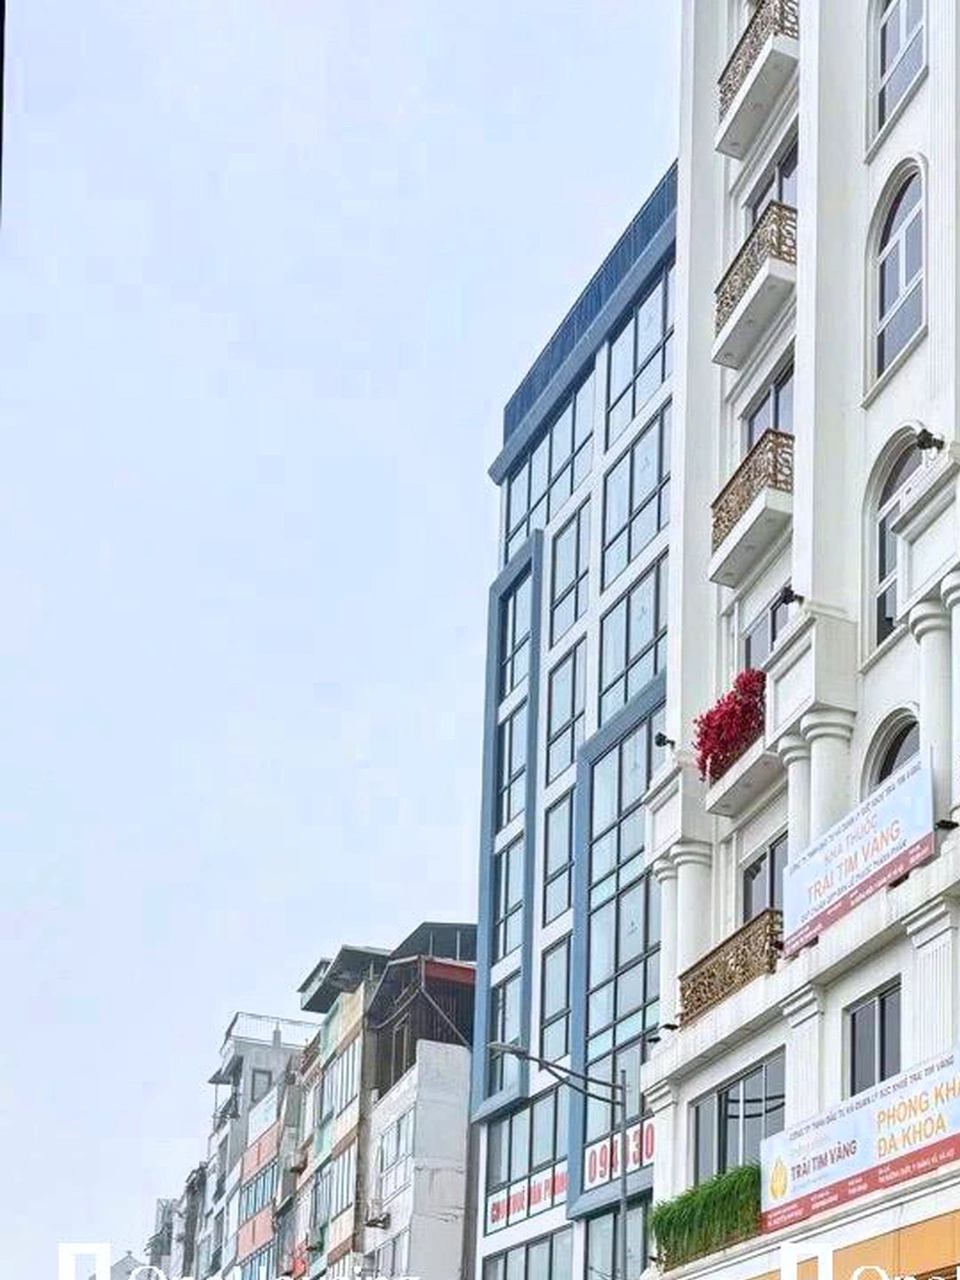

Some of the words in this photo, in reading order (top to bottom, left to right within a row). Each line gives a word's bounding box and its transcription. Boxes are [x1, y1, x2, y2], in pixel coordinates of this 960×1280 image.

[876, 1091, 929, 1133] PHÒNG
[876, 1135, 897, 1160] ĐA
[900, 1114, 948, 1152] KHOA
[812, 1150, 829, 1174] TIM
